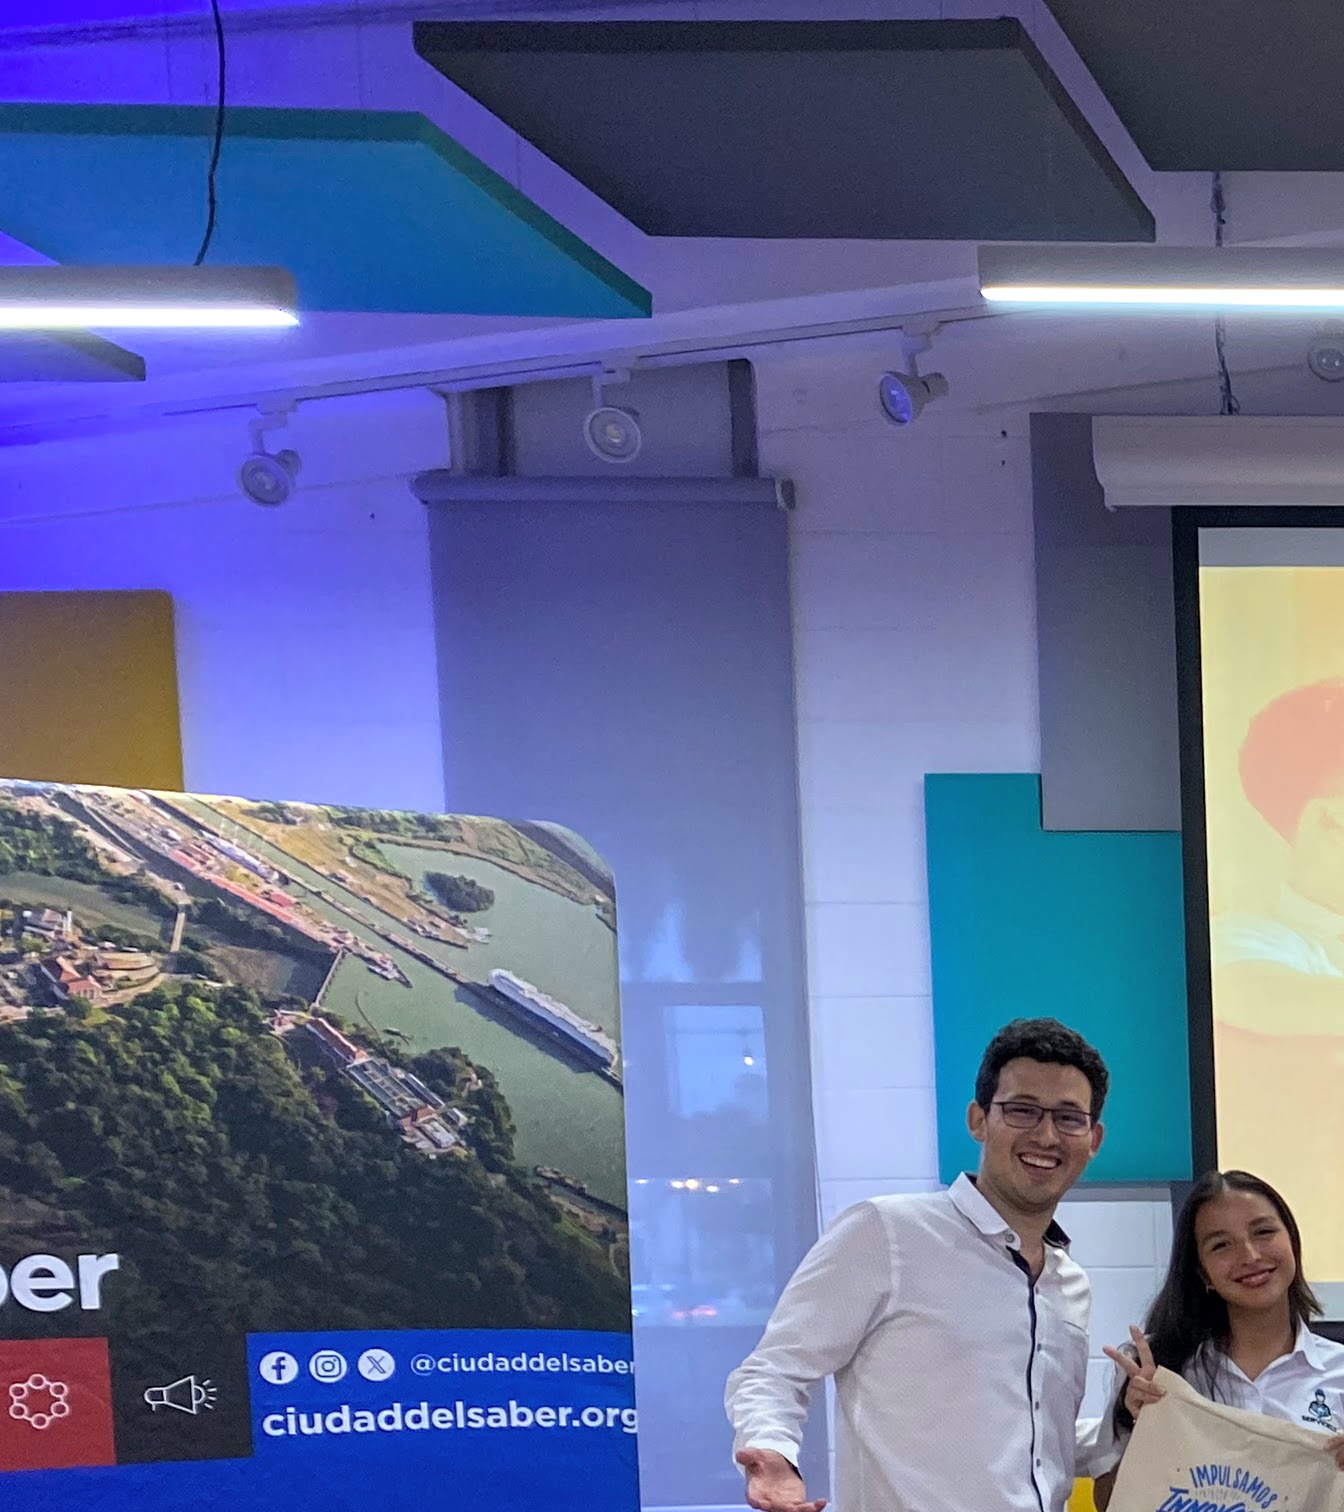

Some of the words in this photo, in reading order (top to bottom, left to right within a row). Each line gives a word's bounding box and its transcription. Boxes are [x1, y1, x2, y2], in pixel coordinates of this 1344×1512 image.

[0, 1252, 119, 1312] er
[262, 1400, 638, 1437] ciudaddelsaber.org
[1190, 1464, 1279, 1509] IMPULSAMOS
